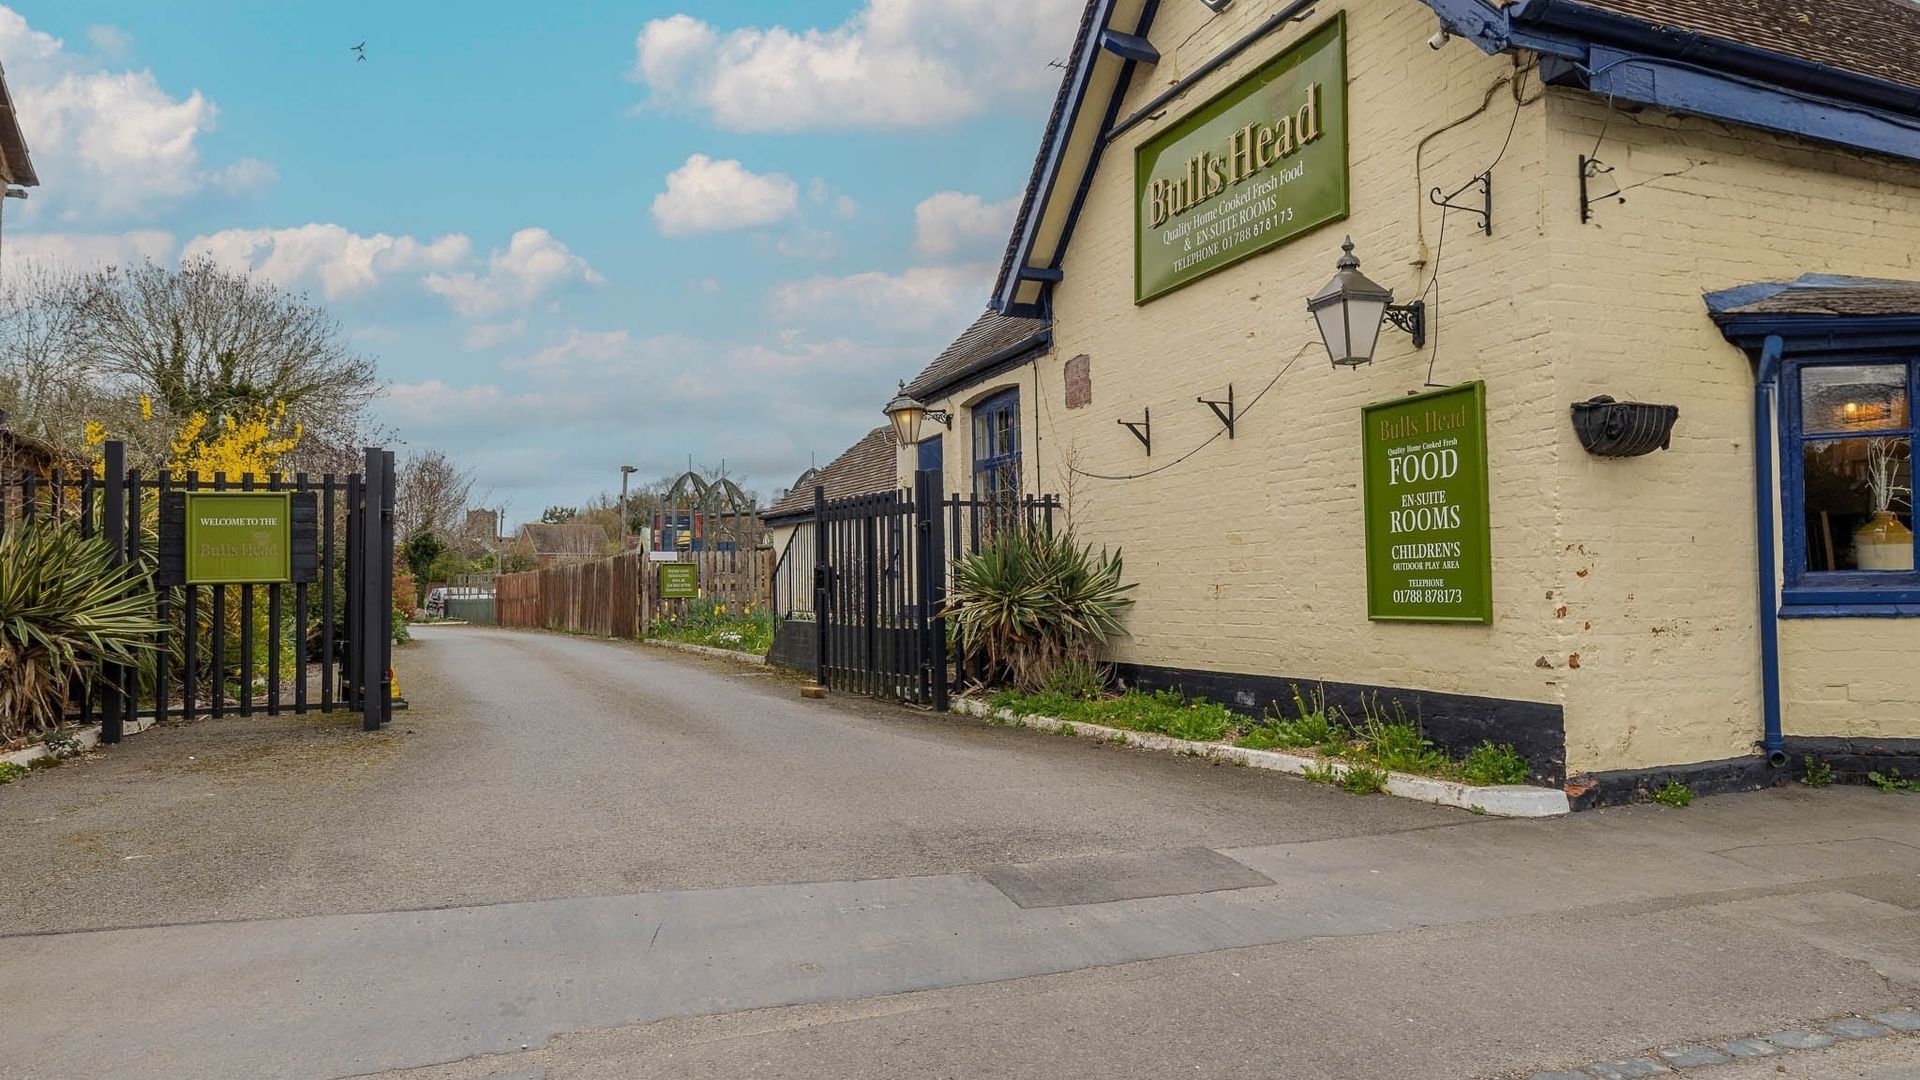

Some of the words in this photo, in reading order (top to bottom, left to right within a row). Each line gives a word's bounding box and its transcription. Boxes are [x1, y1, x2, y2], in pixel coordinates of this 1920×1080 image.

[1148, 151, 1224, 229] Bulls
[1227, 81, 1319, 186] Head
[1163, 220, 1192, 244] Quality
[1193, 208, 1218, 229] Home
[1218, 191, 1251, 215] Cooked
[1253, 175, 1279, 200] Fresh
[1280, 161, 1304, 186] Food
[1183, 237, 1192, 252] &
[1196, 216, 1243, 245] EN-SUITE
[1239, 195, 1277, 224] ROOMS
[1174, 242, 1220, 273] TELEPHONE
[1222, 228, 1251, 250] 01788
[1253, 207, 1294, 237] 878173
[1380, 415, 1418, 441] Bulls
[1425, 404, 1466, 433] Head
[1387, 446, 1406, 456] Quality
[1407, 444, 1421, 452] Home
[1422, 440, 1442, 450] Cooked
[1443, 437, 1458, 447] Fresh
[1388, 449, 1458, 485] FOOD
[1401, 490, 1446, 507] EN-SUITE
[200, 517, 244, 526] WELCOME
[244, 517, 258, 526] TO
[258, 517, 278, 526] THE
[1390, 505, 1461, 533] ROOMS
[201, 543, 238, 557] Bulls
[1391, 541, 1461, 560] CHILDREN'S
[1393, 562, 1423, 571] OUTDOOR
[1425, 561, 1440, 570] PLAY
[1442, 560, 1460, 569] AREA
[1408, 579, 1445, 588] TELEPHONE
[1393, 590, 1422, 603] 01788
[1425, 589, 1462, 603] 878173
